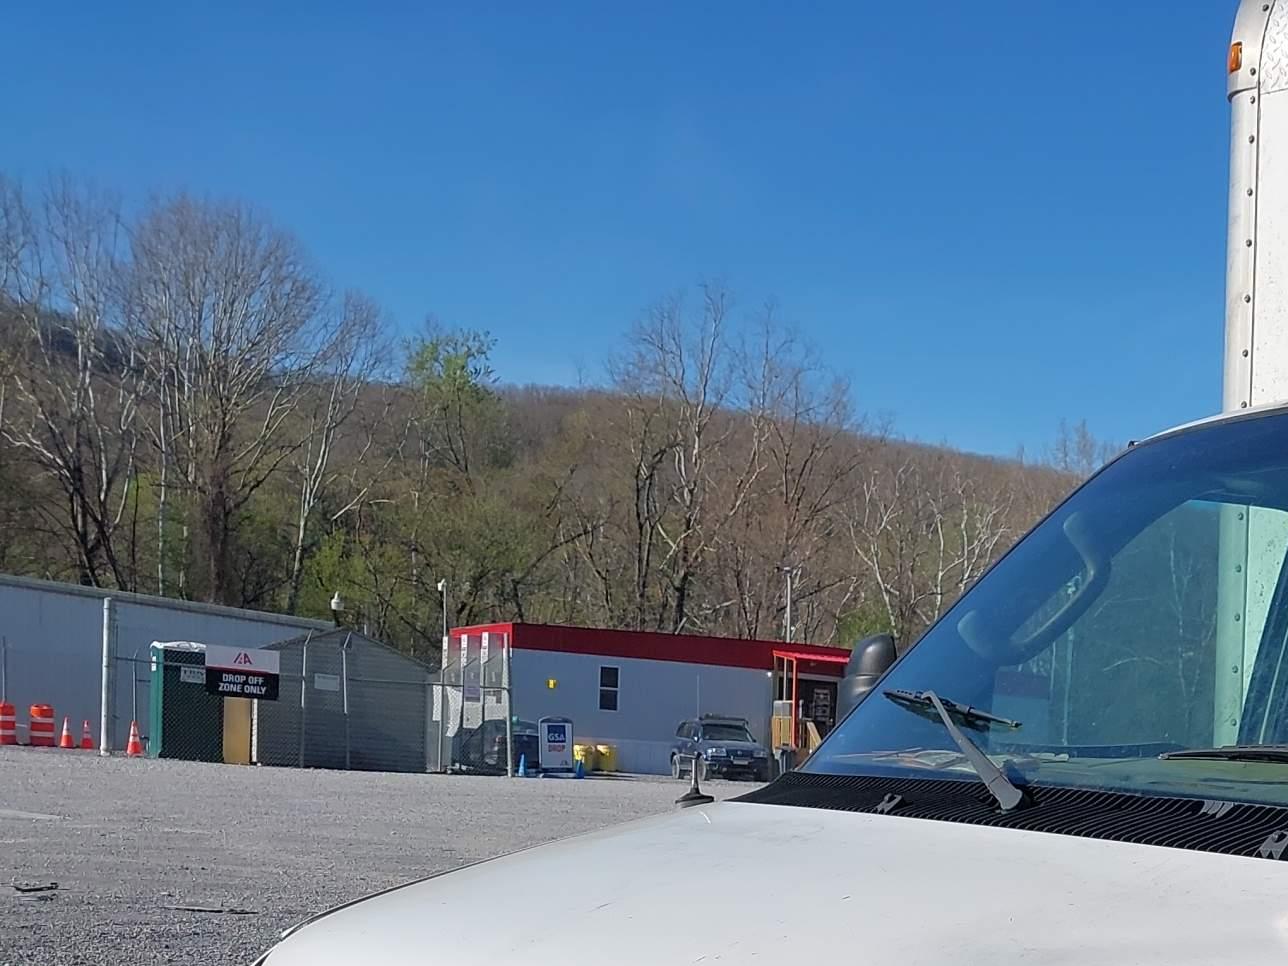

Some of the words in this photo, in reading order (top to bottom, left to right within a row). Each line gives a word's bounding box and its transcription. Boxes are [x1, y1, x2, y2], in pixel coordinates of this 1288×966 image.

[223, 674, 246, 683] DROP
[248, 676, 264, 685] OFF
[219, 683, 242, 692] ZONE
[244, 685, 267, 694] ONLY
[548, 733, 565, 741] GSA
